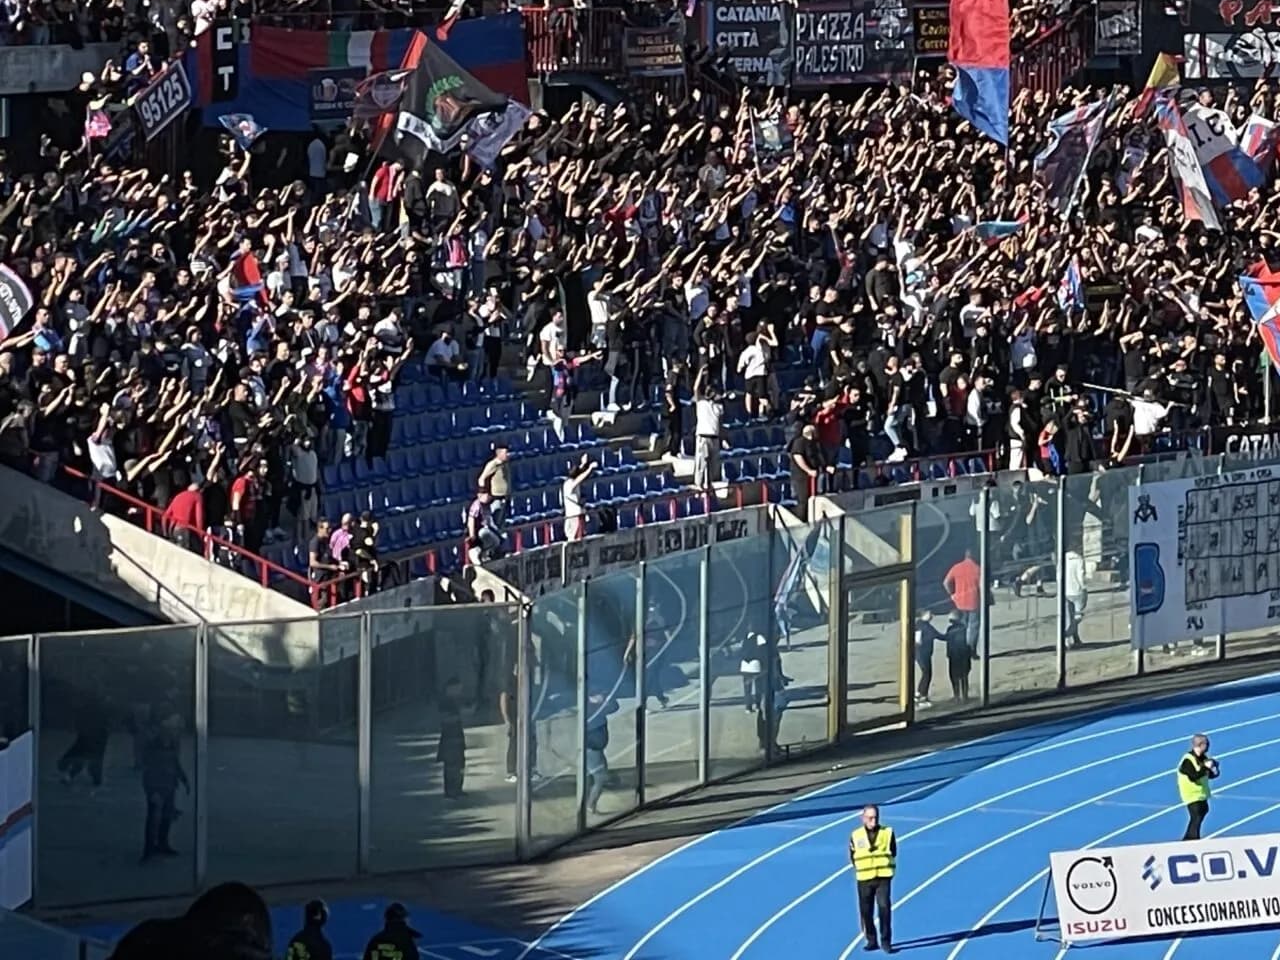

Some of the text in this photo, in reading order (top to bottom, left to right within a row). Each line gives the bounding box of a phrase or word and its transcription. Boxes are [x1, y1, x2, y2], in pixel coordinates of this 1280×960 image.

[716, 5, 782, 22] CATANIA
[796, 12, 865, 41] PIAZZA
[716, 28, 760, 48] CITTÀ
[796, 43, 865, 73] PALESTRO
[140, 73, 186, 128] 95125
[1072, 881, 1112, 891] VOLVO
[1147, 902, 1261, 927] CONCESSIONARIA
[1067, 917, 1128, 936] ISUZU
